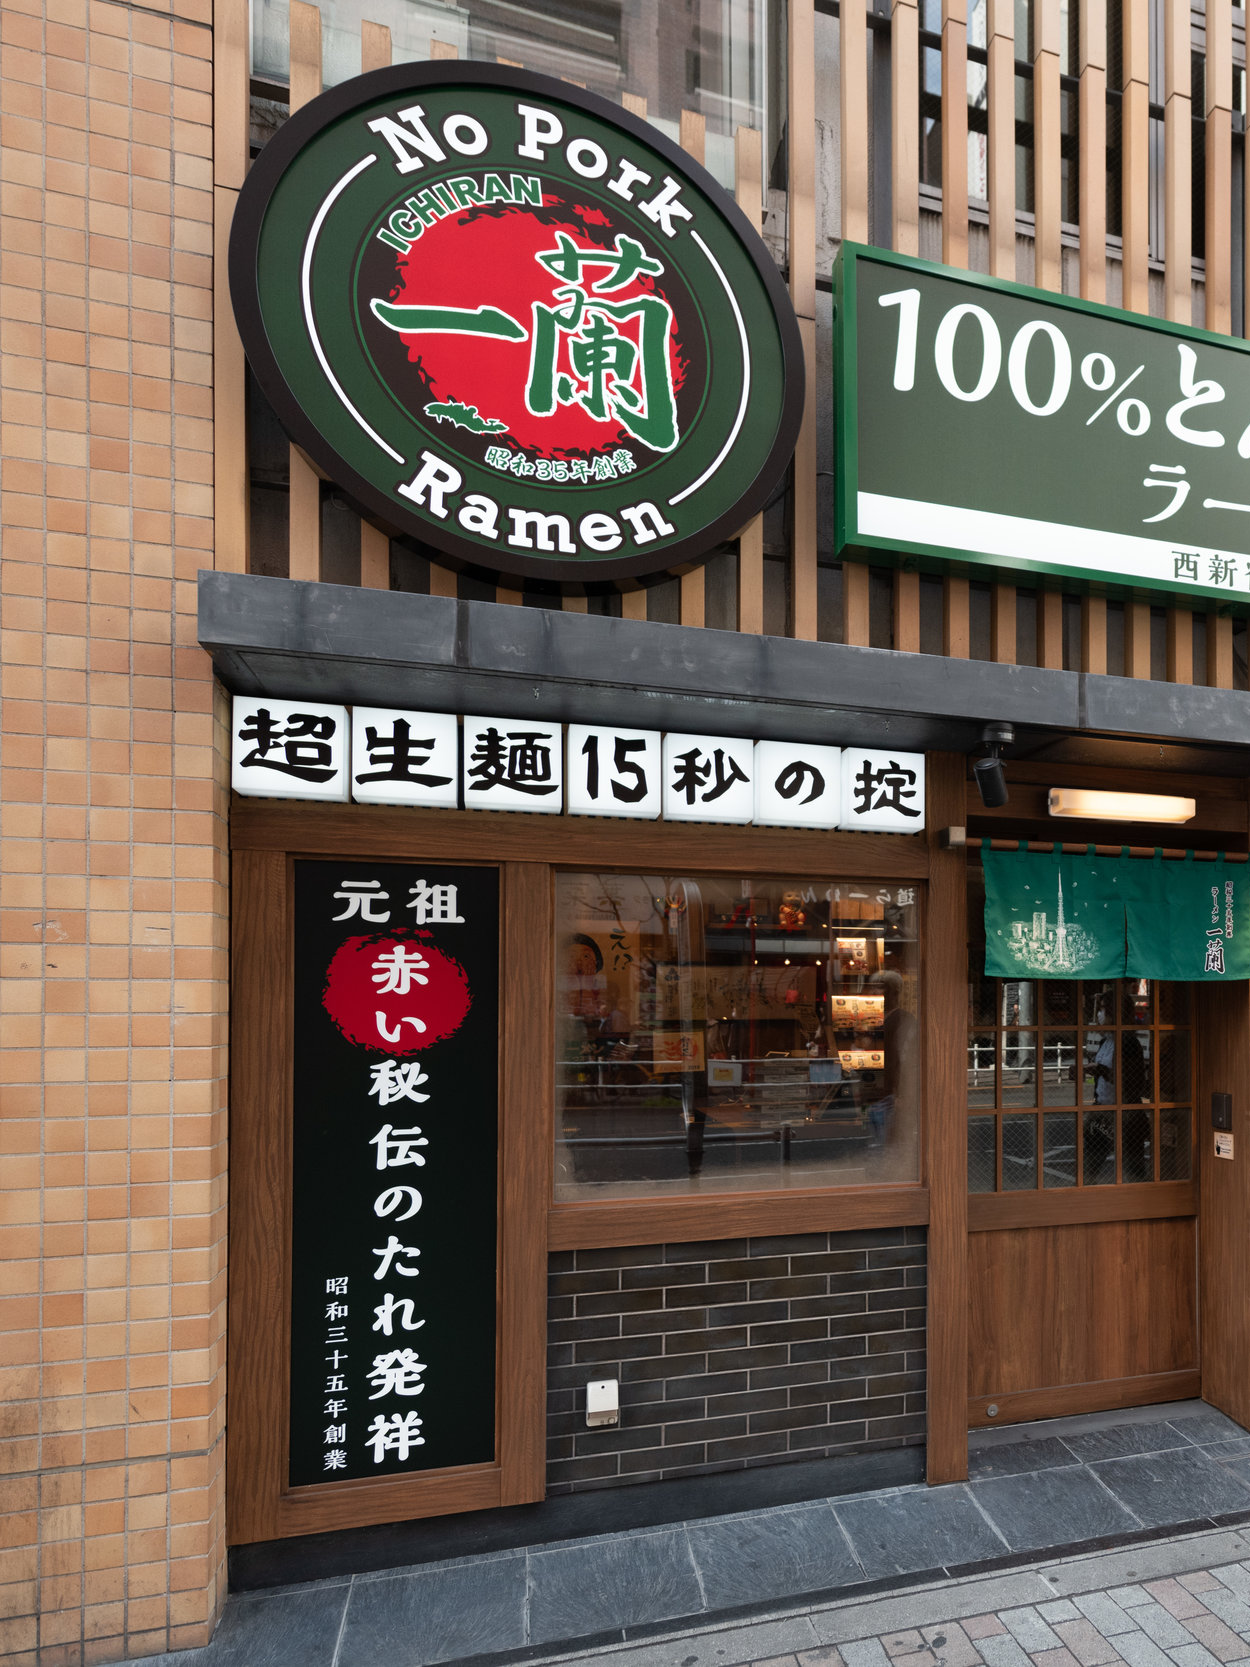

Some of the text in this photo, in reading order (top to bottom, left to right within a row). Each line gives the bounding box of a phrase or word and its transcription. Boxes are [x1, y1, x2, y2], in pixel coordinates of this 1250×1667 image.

[370, 103, 694, 239] No Pork
[378, 173, 543, 255] ICHIRAN
[369, 230, 680, 453] 一蘭
[398, 450, 675, 555] Ramen
[484, 446, 638, 485] 昭和35年創業
[237, 707, 923, 819] 超生麺15秒の掟
[331, 878, 467, 926] 元祖
[1205, 927, 1225, 974] 一蘭
[1211, 886, 1219, 924] ラーメン
[365, 944, 432, 1466] 赤い秘伝のたれ発祥
[324, 1275, 350, 1472] 昭和三十五年創業
